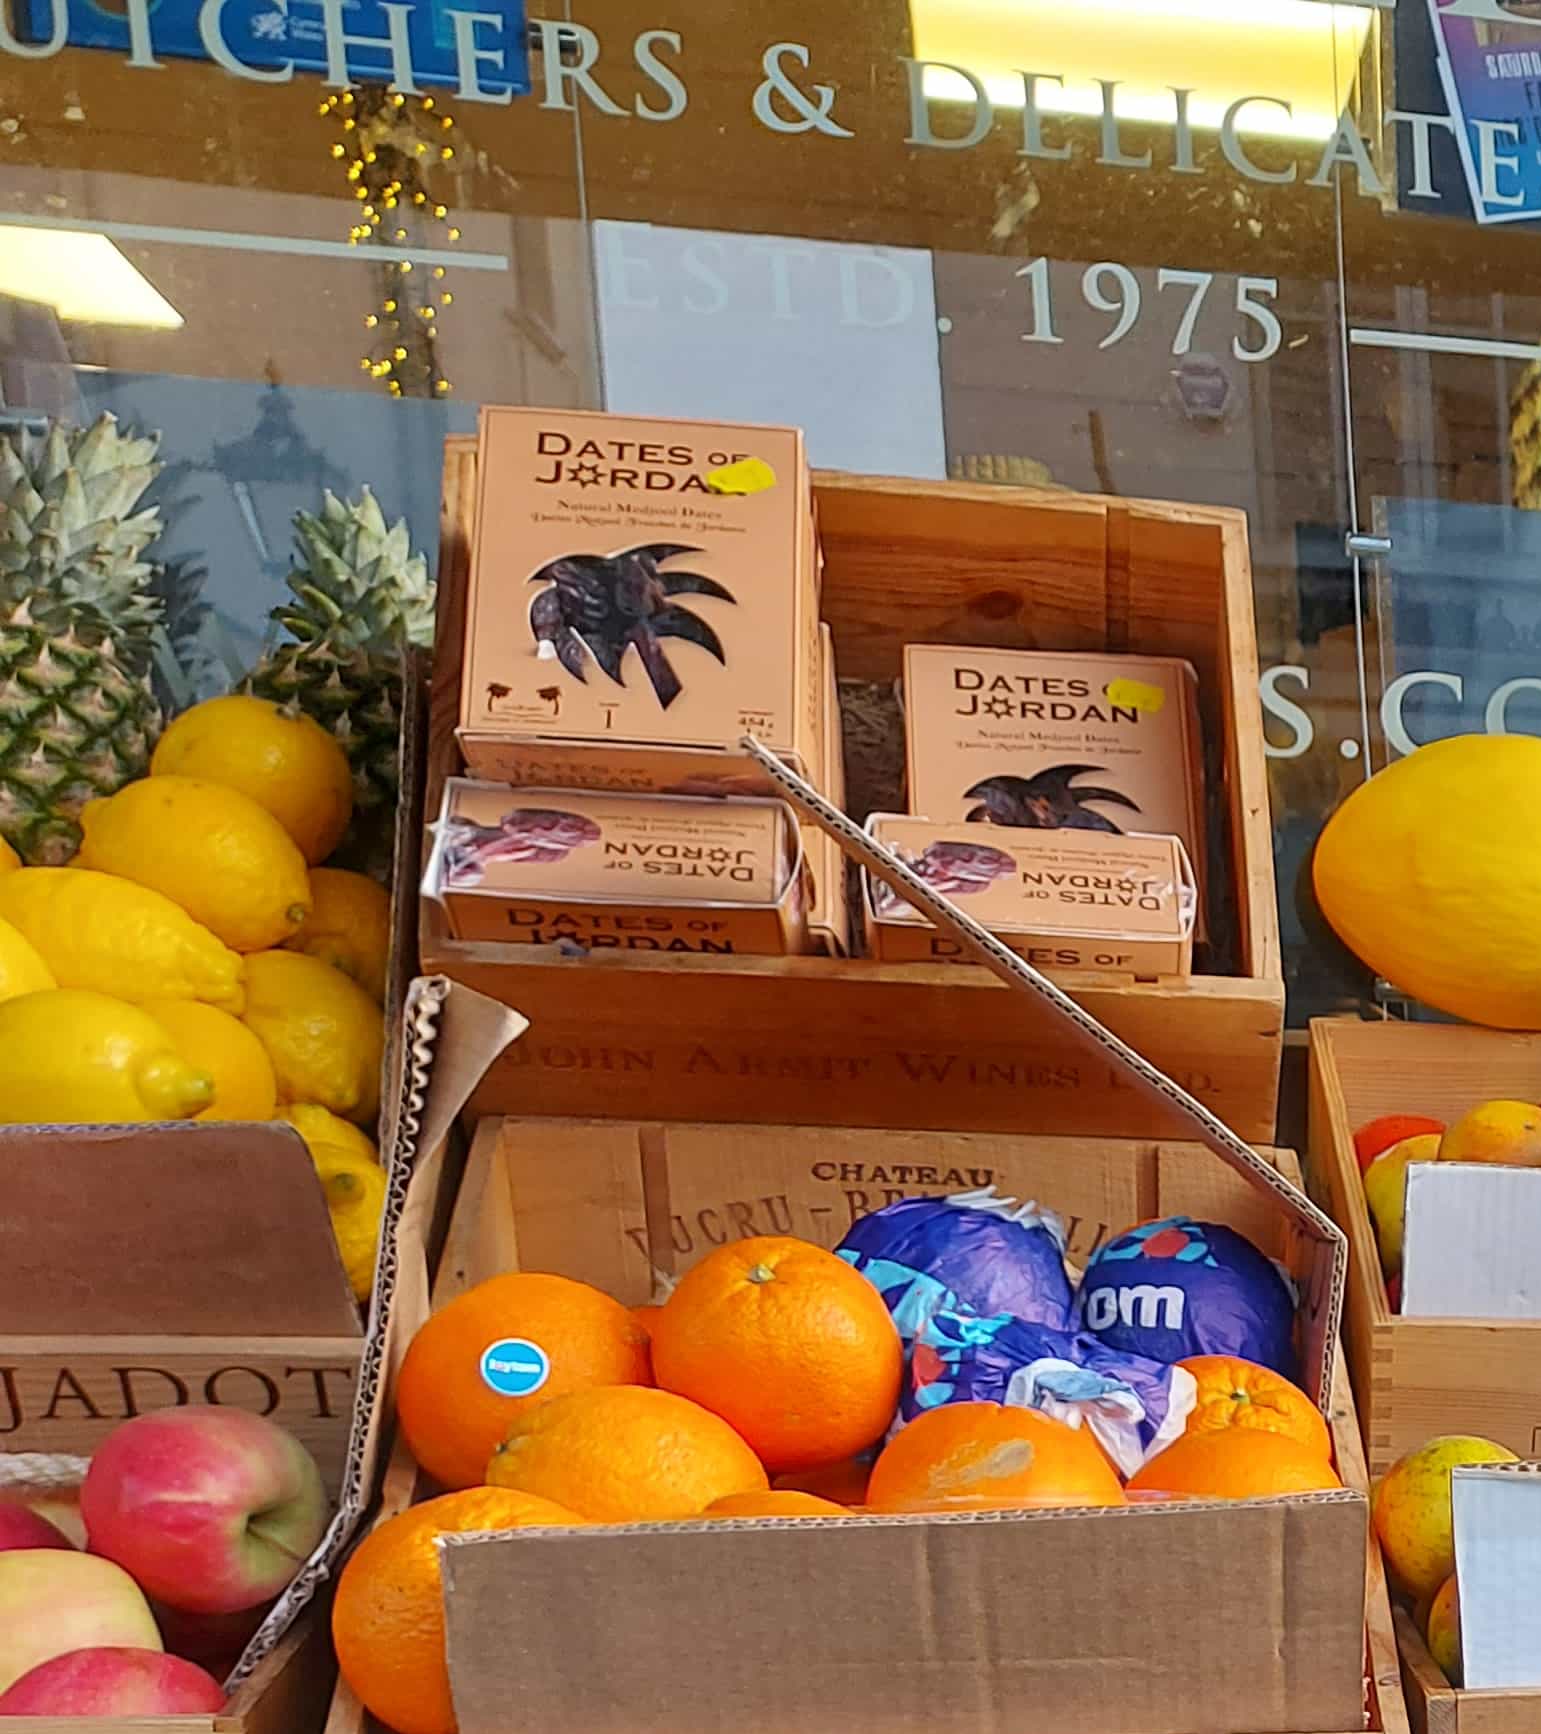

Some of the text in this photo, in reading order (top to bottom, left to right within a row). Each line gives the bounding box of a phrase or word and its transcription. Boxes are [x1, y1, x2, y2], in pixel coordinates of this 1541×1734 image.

[752, 42, 854, 138] &
[603, 223, 1284, 362] ESTD. 1975
[536, 431, 694, 467] DATES
[953, 668, 1090, 697] DATES
[954, 694, 1139, 724] JORDAN
[603, 840, 756, 866] JORDAN
[643, 860, 755, 883] DATES
[1021, 871, 1163, 893] JORDAN
[1059, 890, 1163, 911] DATES
[508, 908, 730, 933] DATES OF
[1094, 950, 1134, 965] OF
[504, 1046, 656, 1074] JOHN
[897, 1051, 1082, 1090] WINES
[810, 1161, 996, 1189] CHATEAU
[0, 1366, 352, 1433] JADOT
